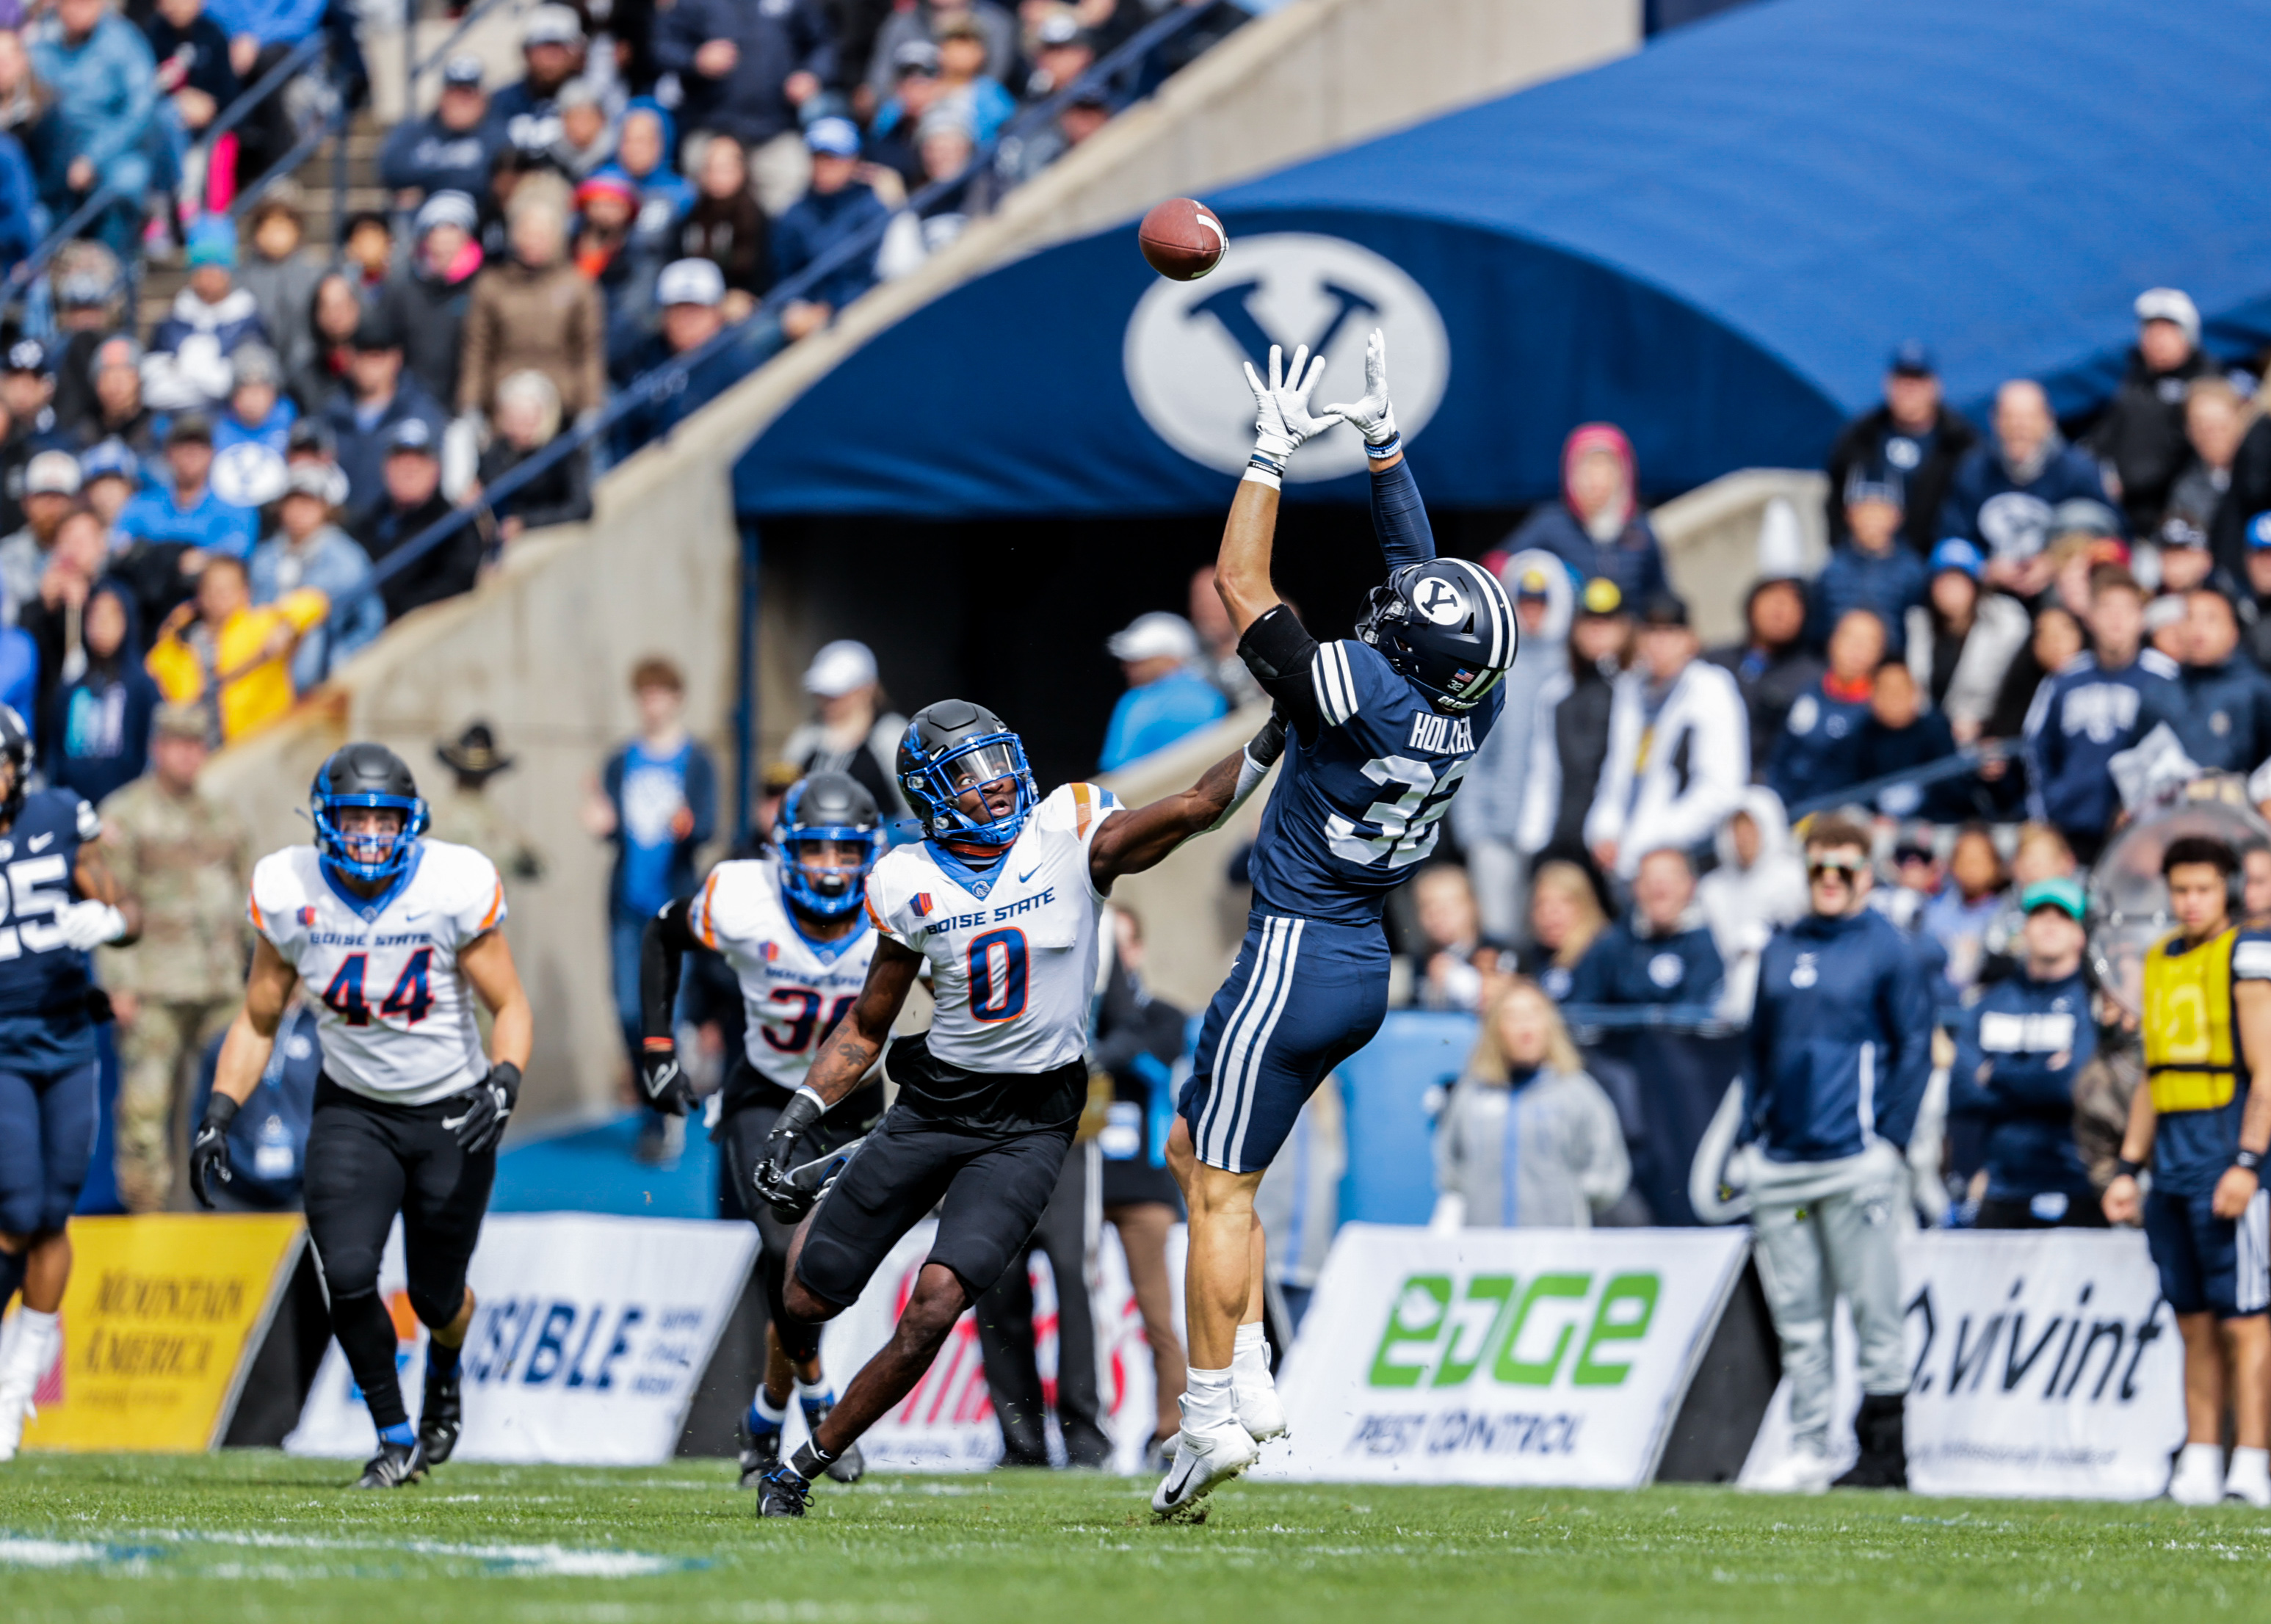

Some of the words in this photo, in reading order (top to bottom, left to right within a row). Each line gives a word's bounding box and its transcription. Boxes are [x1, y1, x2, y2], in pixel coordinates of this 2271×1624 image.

[1421, 580, 1458, 615] Y
[1438, 695, 1456, 706] GO
[1447, 679, 1464, 692] 32
[1409, 712, 1476, 754] HOLKER
[1324, 754, 1476, 869] 32
[924, 911, 986, 935] BOISE
[993, 886, 1055, 921] STATE
[309, 933, 366, 946] BOISE
[374, 933, 432, 946] STATE
[321, 946, 435, 1029] 44
[966, 926, 1029, 1023] 0
[468, 1297, 645, 1388] SIBLE
[1427, 1409, 1587, 1455] CONTROL
